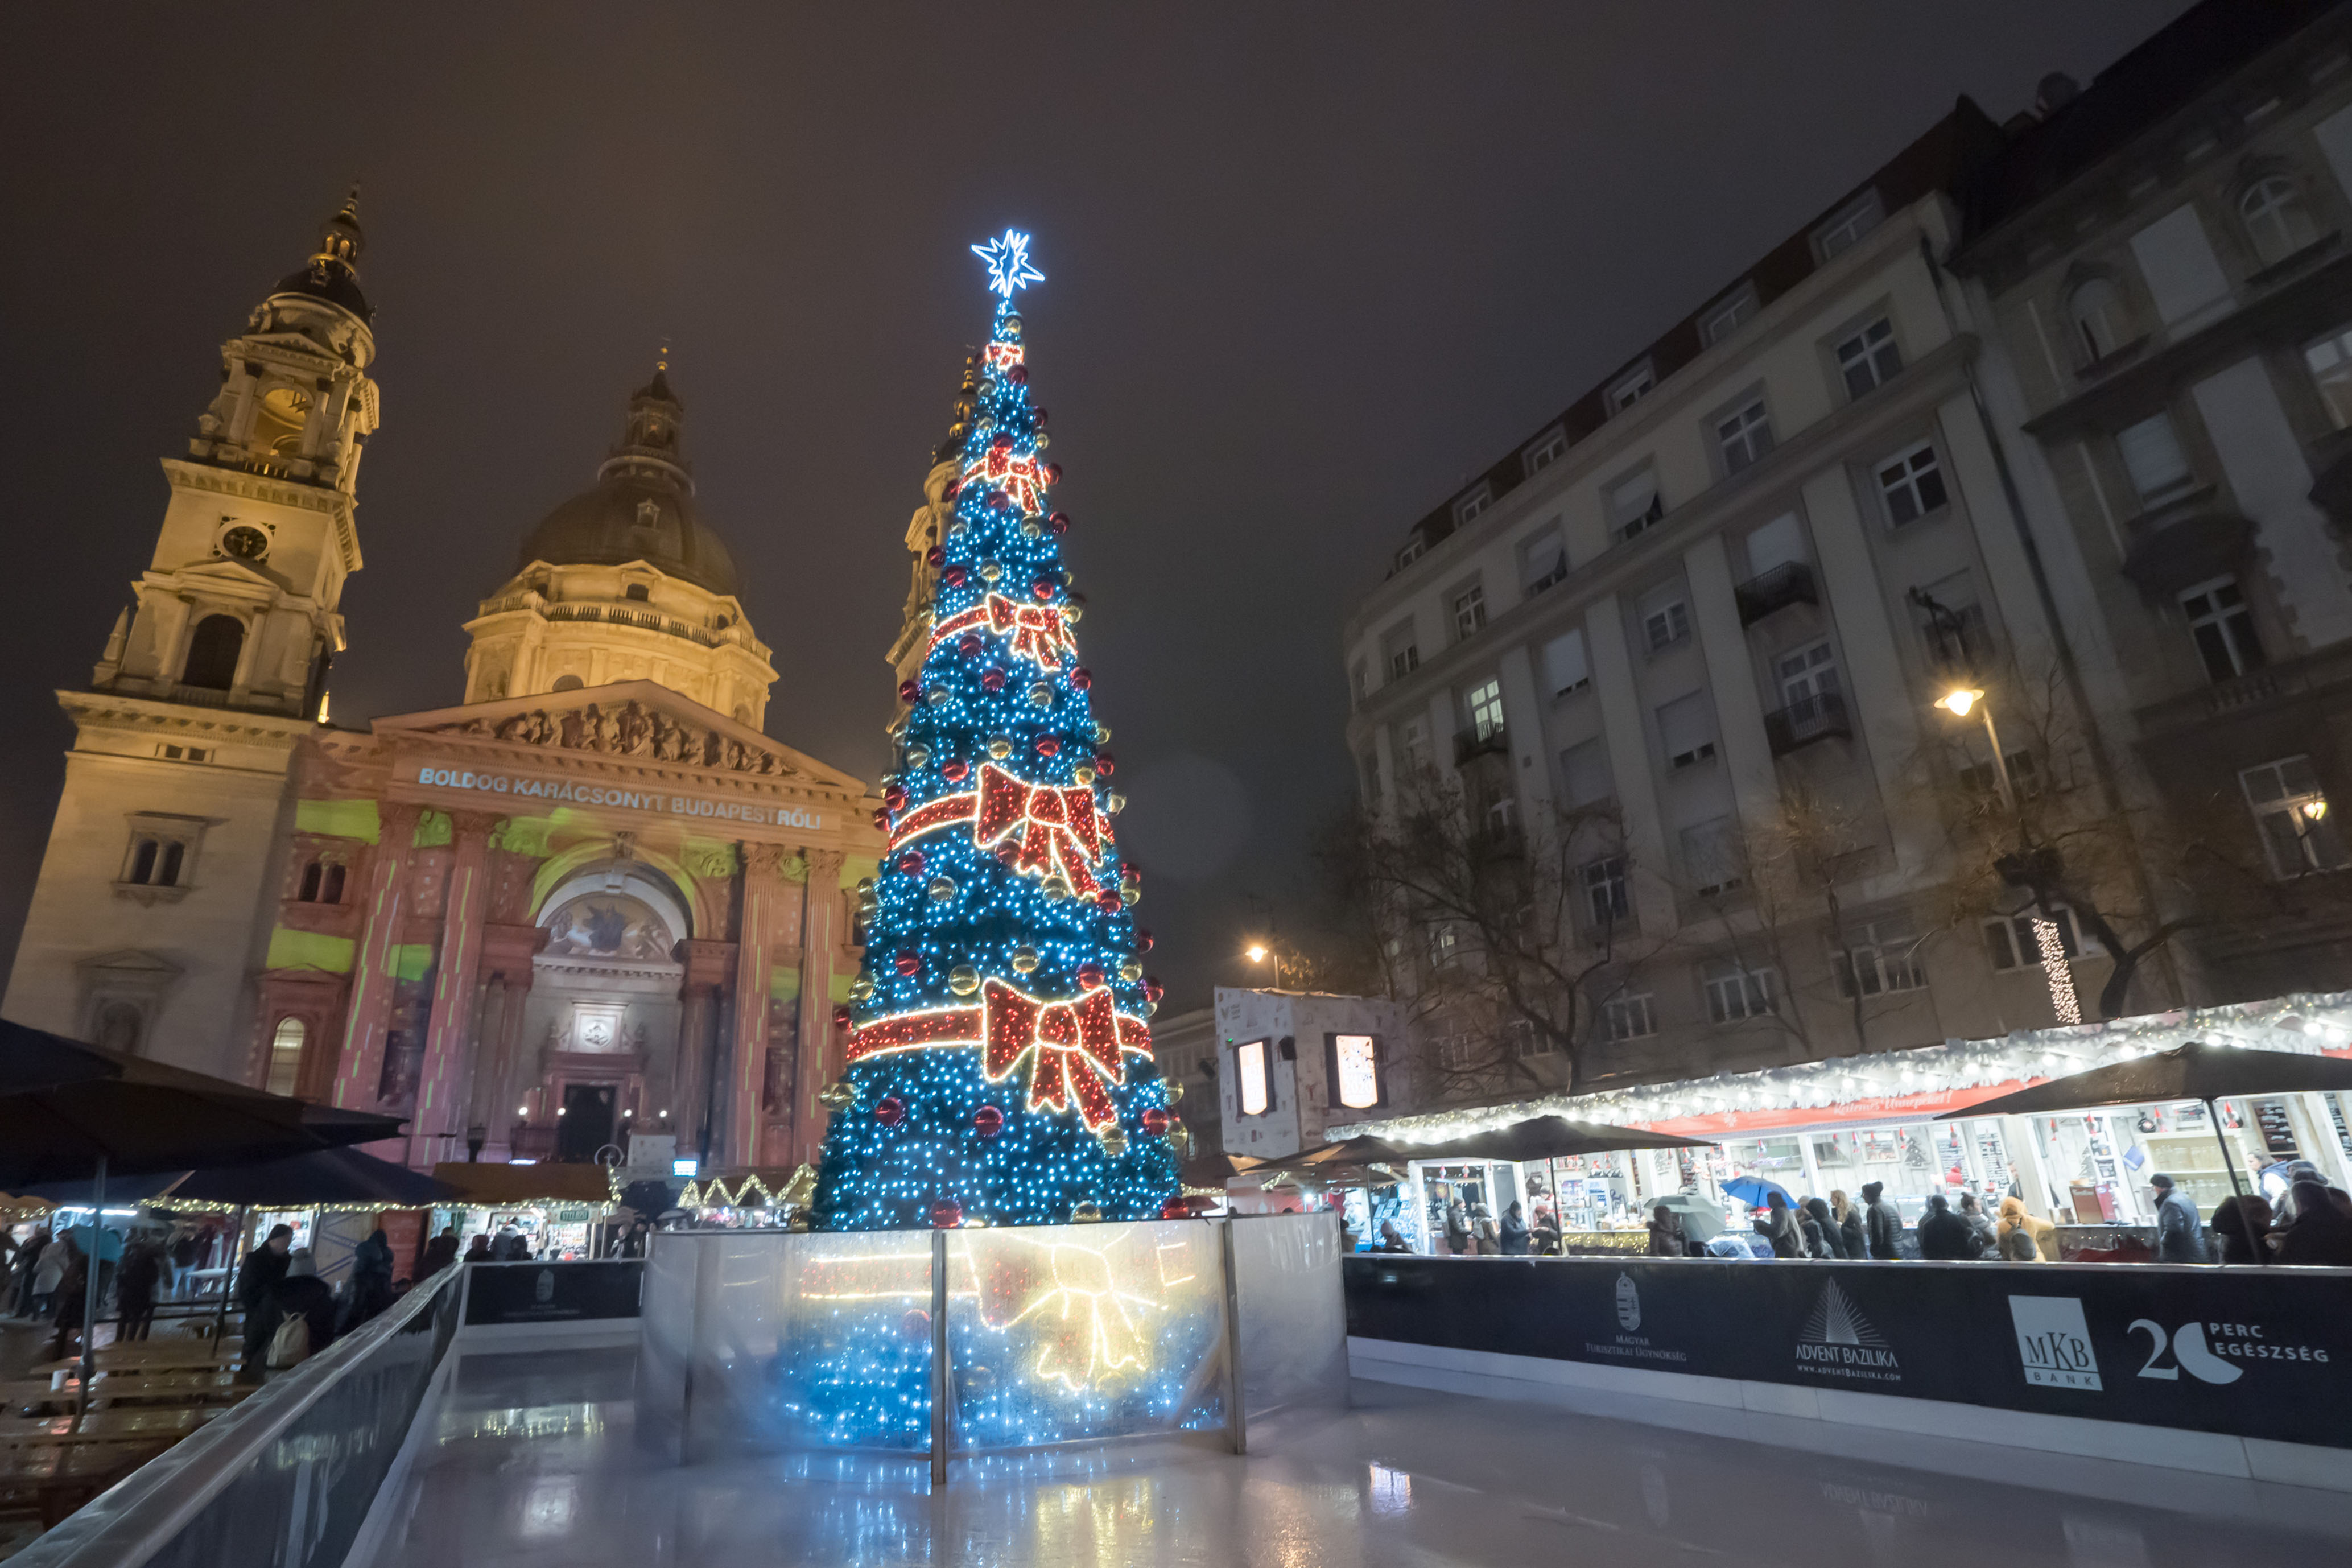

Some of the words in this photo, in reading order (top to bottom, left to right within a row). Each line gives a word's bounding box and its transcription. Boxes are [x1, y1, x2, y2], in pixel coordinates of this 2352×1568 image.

[419, 768, 508, 793] BOLDOG
[513, 779, 663, 811] KARÁCSONYT
[2209, 1323, 2263, 1338] PERC
[1796, 1344, 1840, 1363] ADVENT
[1842, 1347, 1899, 1368] BAZILIKA
[2025, 1332, 2090, 1371] MKB
[2215, 1342, 2329, 1363] EGÉSZSÉG
[2033, 1372, 2093, 1385] BANK
